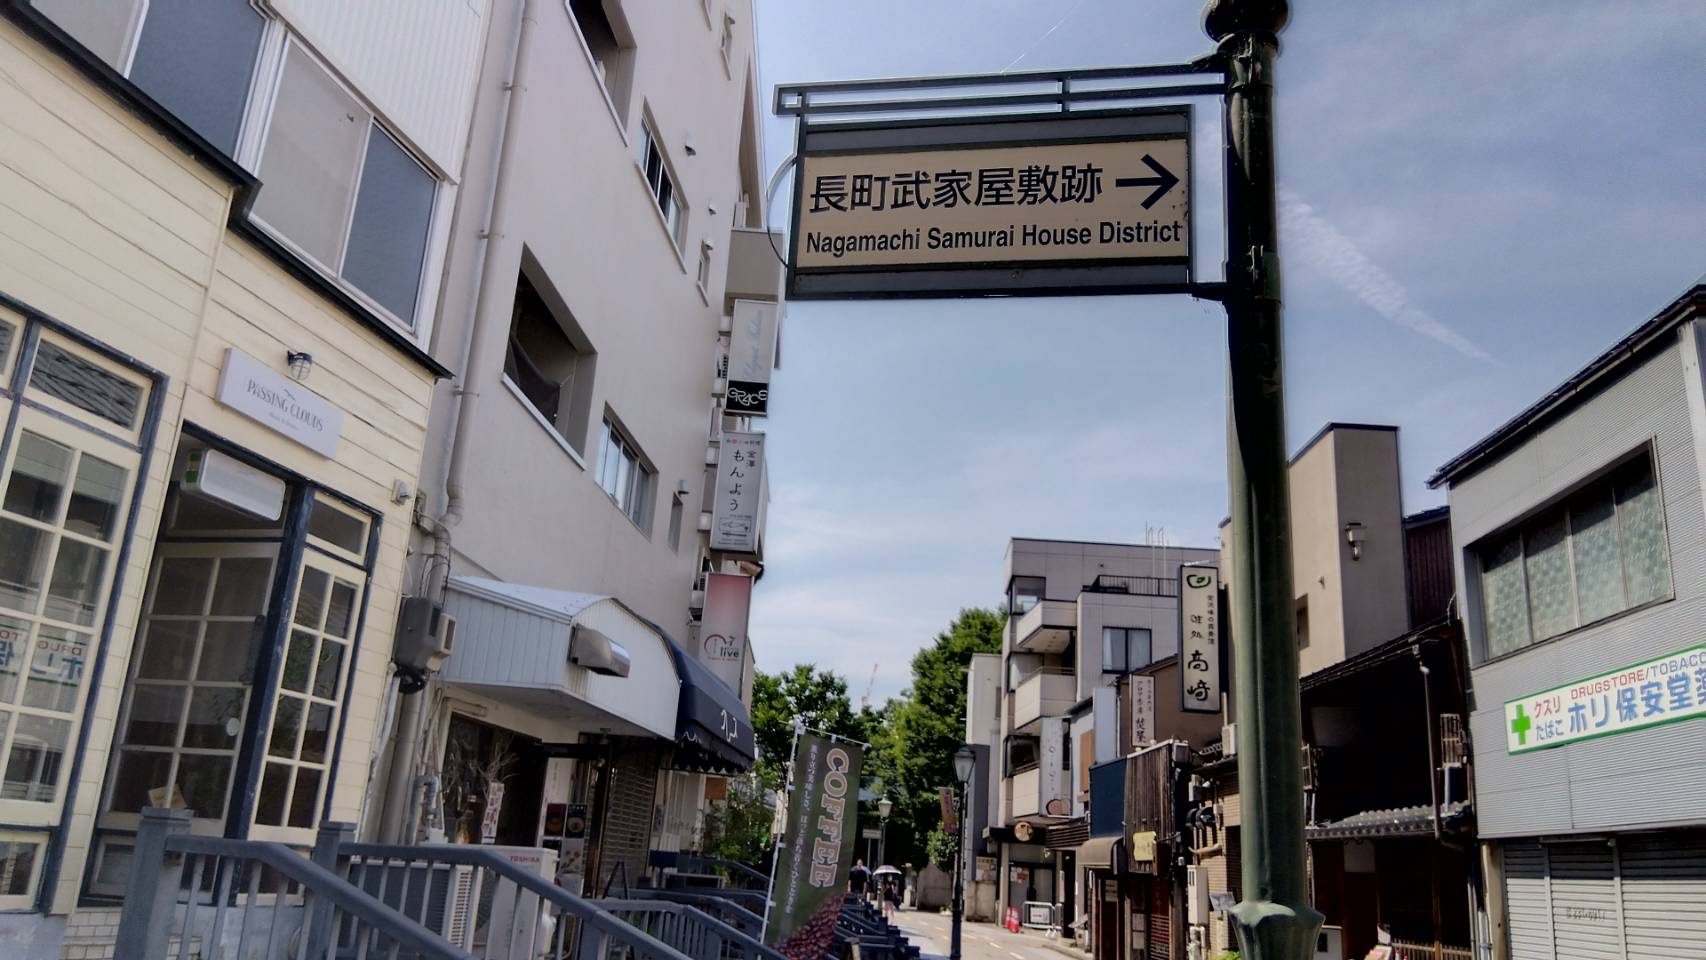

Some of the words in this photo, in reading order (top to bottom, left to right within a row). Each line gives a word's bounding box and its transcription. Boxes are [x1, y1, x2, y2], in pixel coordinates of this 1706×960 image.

[809, 163, 1103, 213] 長町武家屋敷跡
[806, 229, 920, 258] Nagamachi
[927, 225, 1014, 249] Samurai
[1022, 224, 1092, 246] House
[1100, 220, 1181, 244] District
[247, 378, 289, 412] PASSING
[289, 402, 324, 432] CLOUDS
[727, 387, 768, 406] GRACE
[729, 449, 745, 511] もんよう
[1534, 695, 1561, 719] クスリ
[1535, 719, 1565, 741] たばこ
[809, 748, 850, 888] COFFEE
